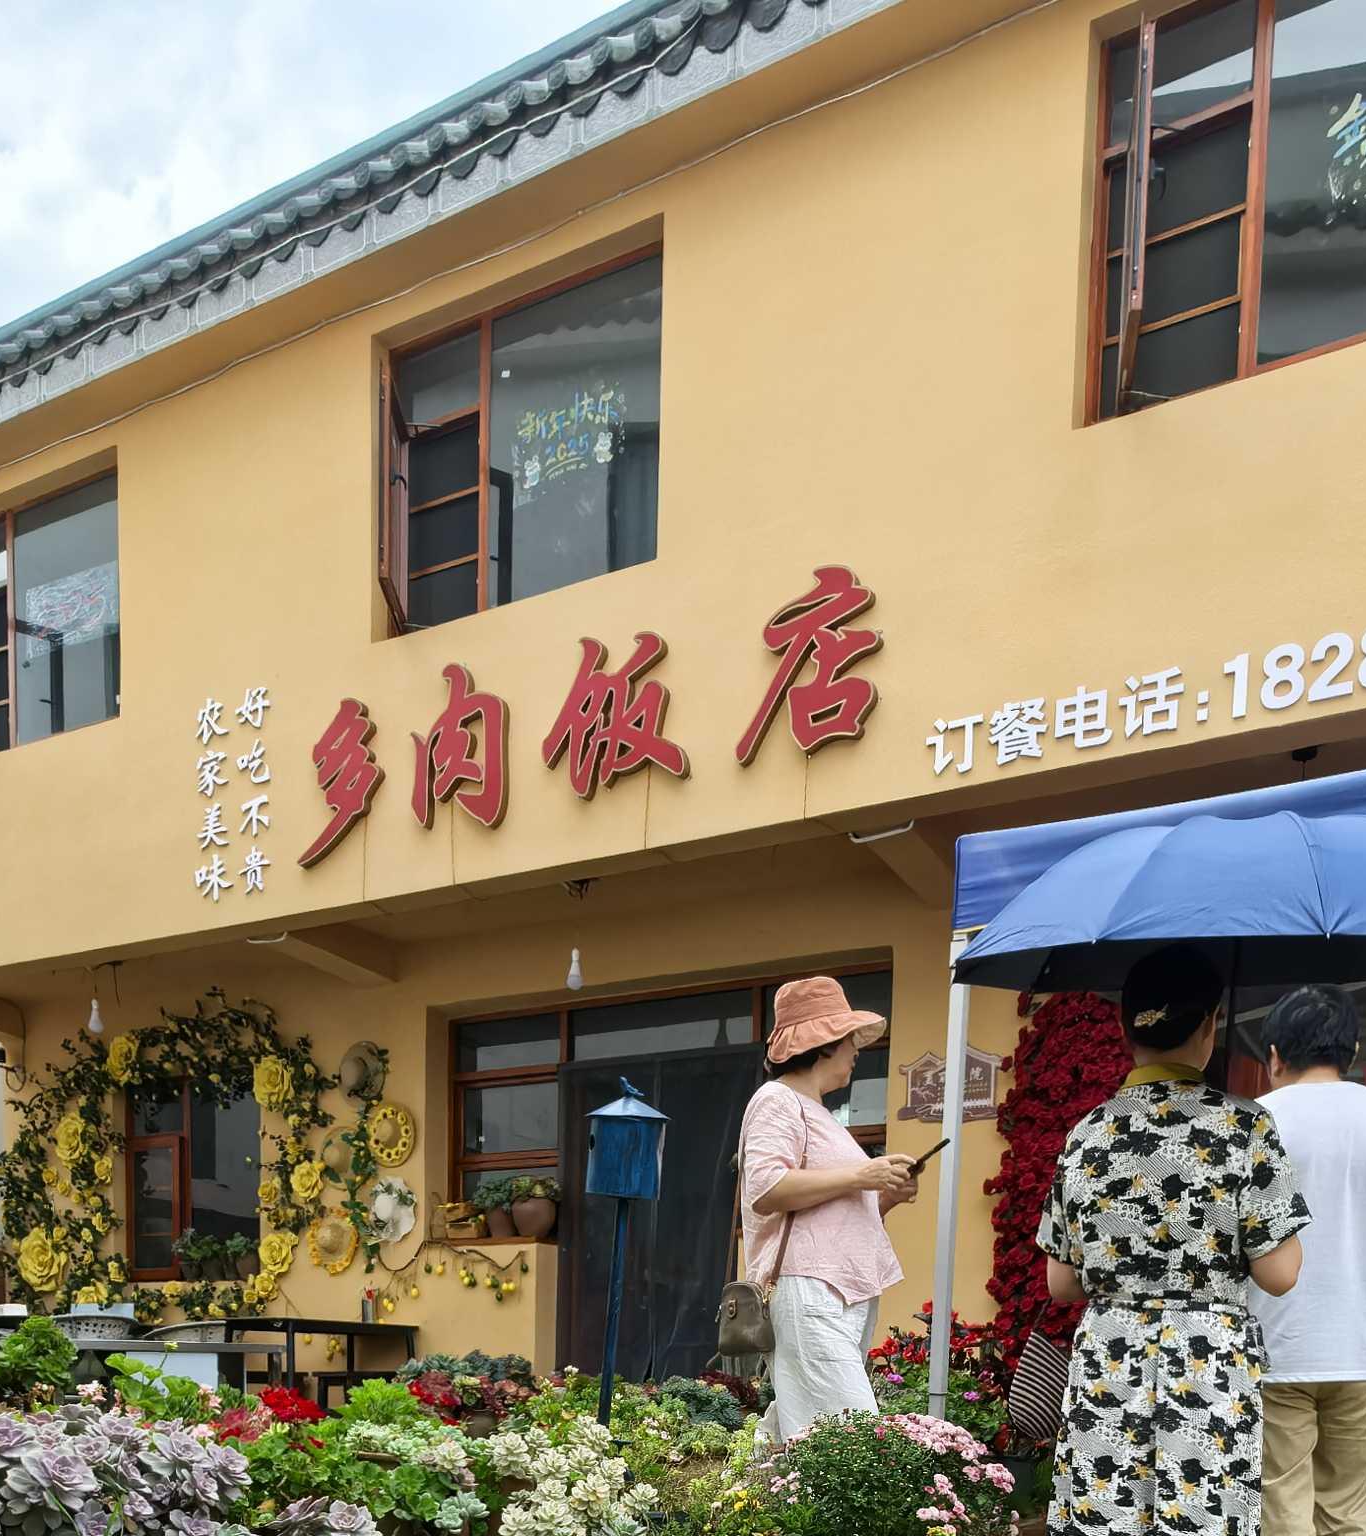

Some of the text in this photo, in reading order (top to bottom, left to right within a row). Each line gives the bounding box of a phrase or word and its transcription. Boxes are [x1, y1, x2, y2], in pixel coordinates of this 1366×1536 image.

[195, 698, 234, 903] 农家美味
[235, 686, 271, 895] 好吃不贵
[296, 564, 884, 869] 多肉饭店
